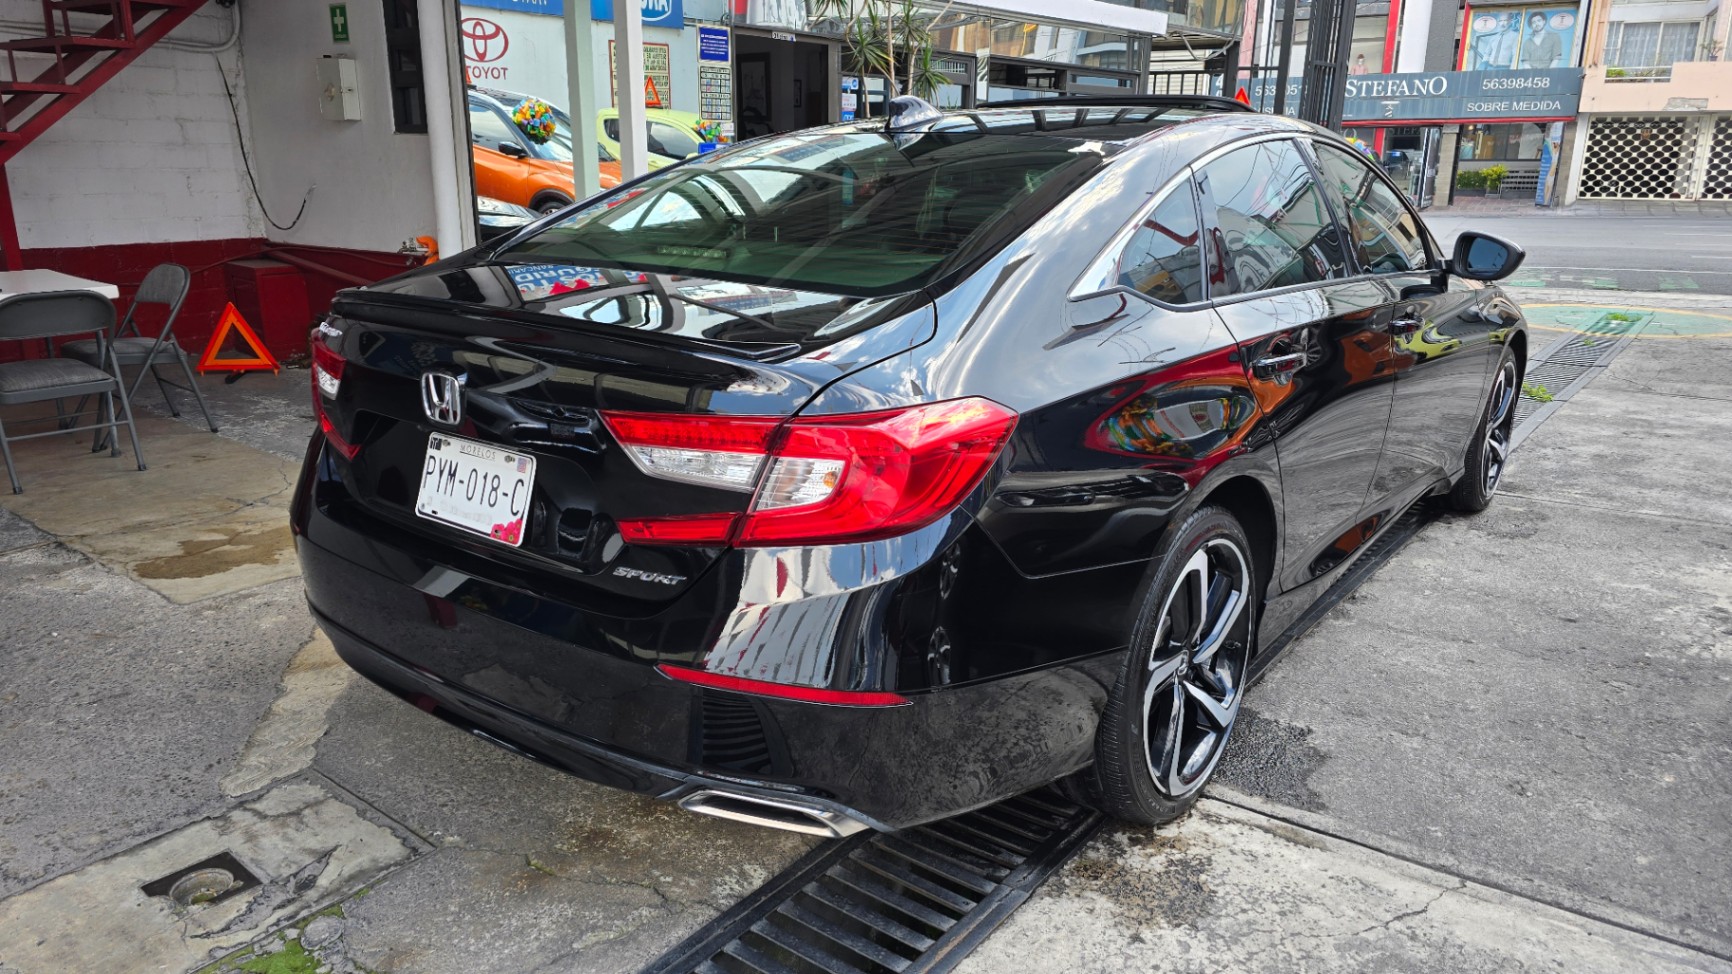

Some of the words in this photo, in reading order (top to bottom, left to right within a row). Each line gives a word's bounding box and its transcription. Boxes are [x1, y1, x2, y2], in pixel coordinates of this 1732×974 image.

[1345, 75, 1449, 98] STEFANO
[1482, 77, 1551, 91] 56398458
[1466, 101, 1509, 113] SOBRE
[1511, 100, 1562, 112] MEDIDA
[459, 442, 497, 461] MORELOS
[422, 455, 526, 517] PYM-018-C
[612, 566, 688, 585] SPORT
